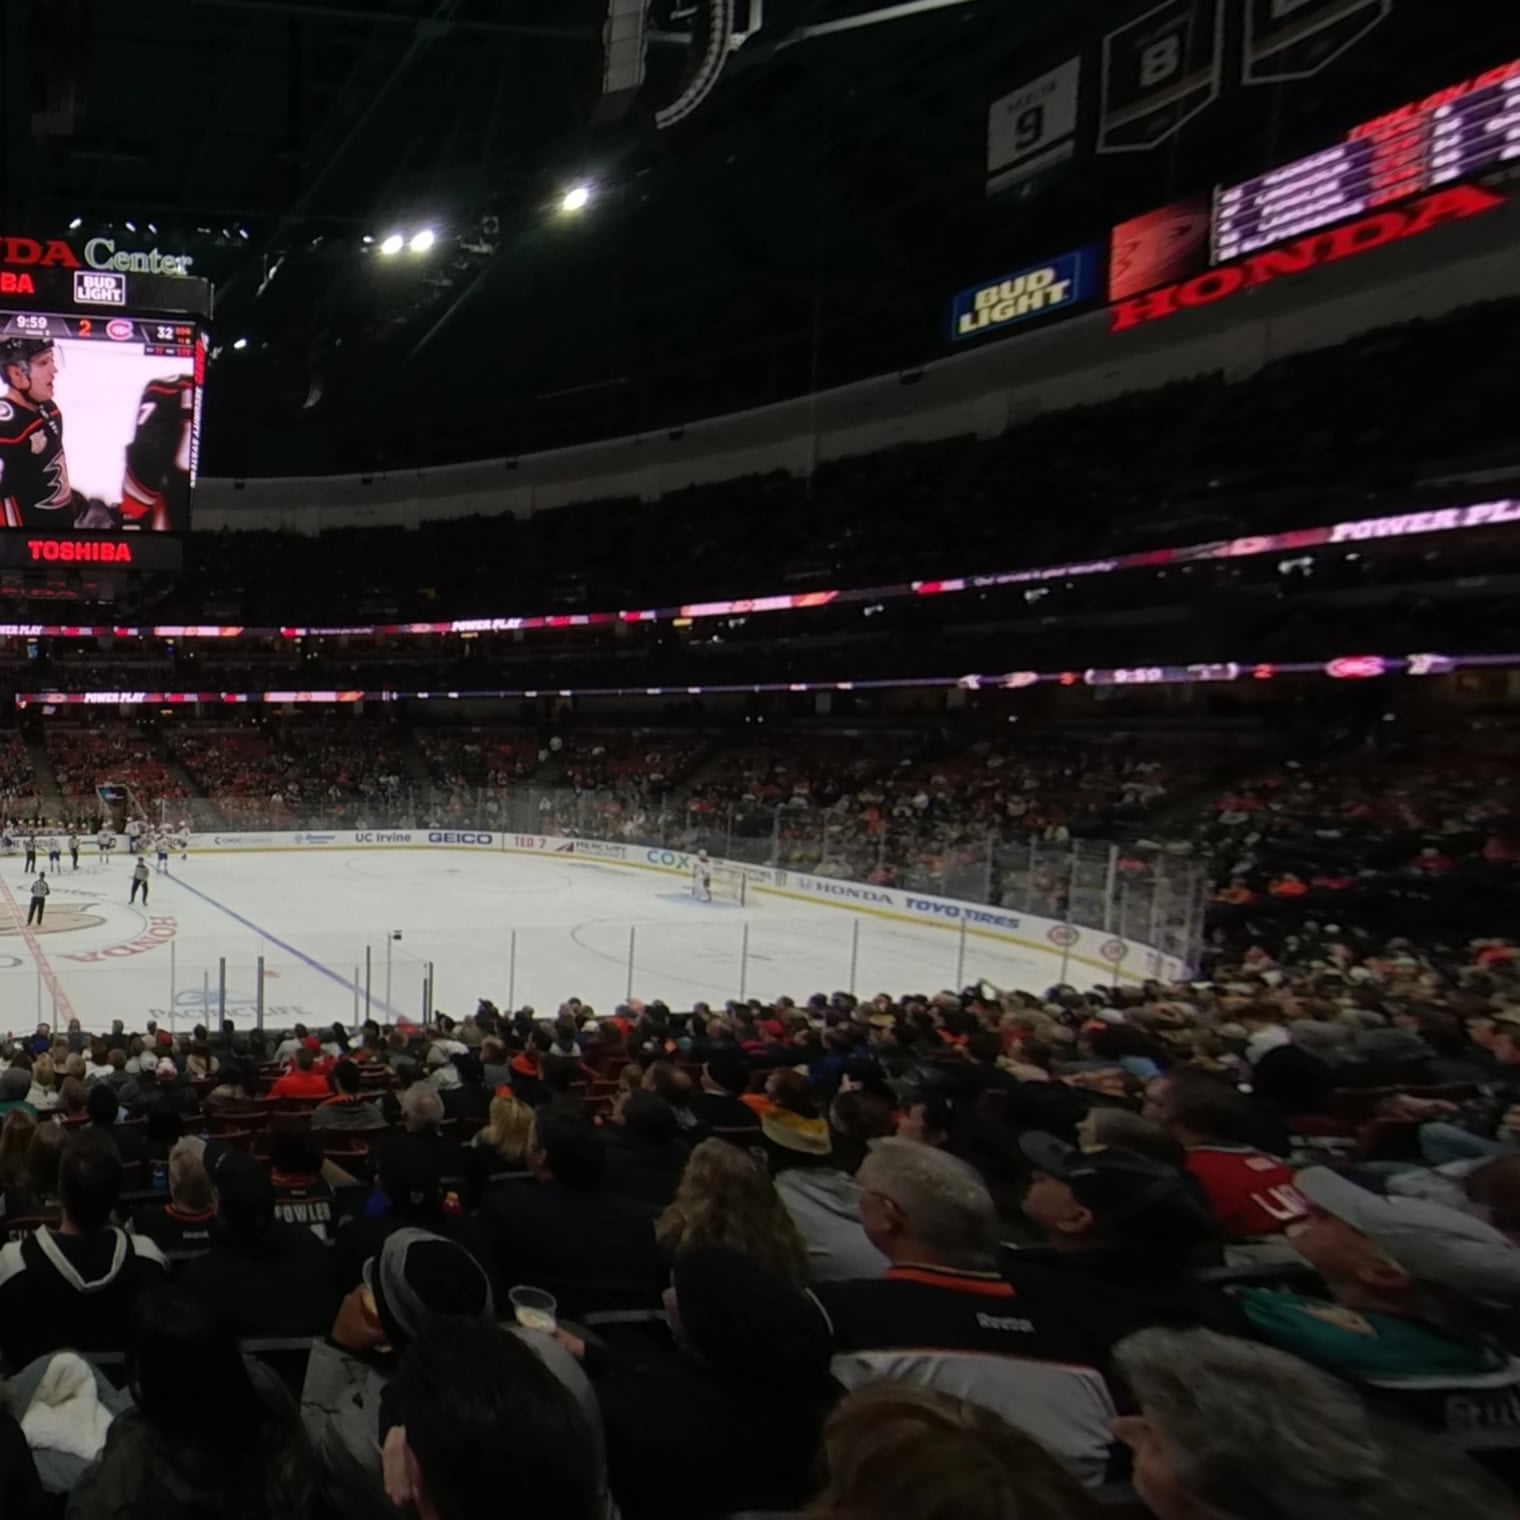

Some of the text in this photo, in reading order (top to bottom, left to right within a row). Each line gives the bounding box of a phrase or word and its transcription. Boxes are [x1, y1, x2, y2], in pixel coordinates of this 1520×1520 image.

[1139, 34, 1180, 87] 8
[1014, 106, 1043, 150] 9
[84, 237, 193, 276] Center
[1109, 184, 1508, 333] HONDA
[82, 275, 116, 290] BUD
[974, 267, 1055, 310] BUD
[77, 287, 123, 302] LIGHT
[958, 280, 1069, 336] LIGHT
[16, 315, 47, 329] 9:59
[78, 319, 92, 337] 2
[157, 326, 174, 340] 32
[1329, 508, 1466, 543] POWER
[27, 540, 132, 562] TOSHIBA
[18, 625, 43, 635] PLAY
[451, 617, 522, 632] POWER PLAY
[1114, 667, 1161, 683] 9:59
[83, 692, 146, 704] POWER PLAY
[356, 832, 411, 843] UC Irvine
[428, 833, 492, 845] GEICO
[646, 850, 690, 869] COX
[815, 881, 893, 905] HONDA
[905, 897, 1022, 929] TOYO TIRES
